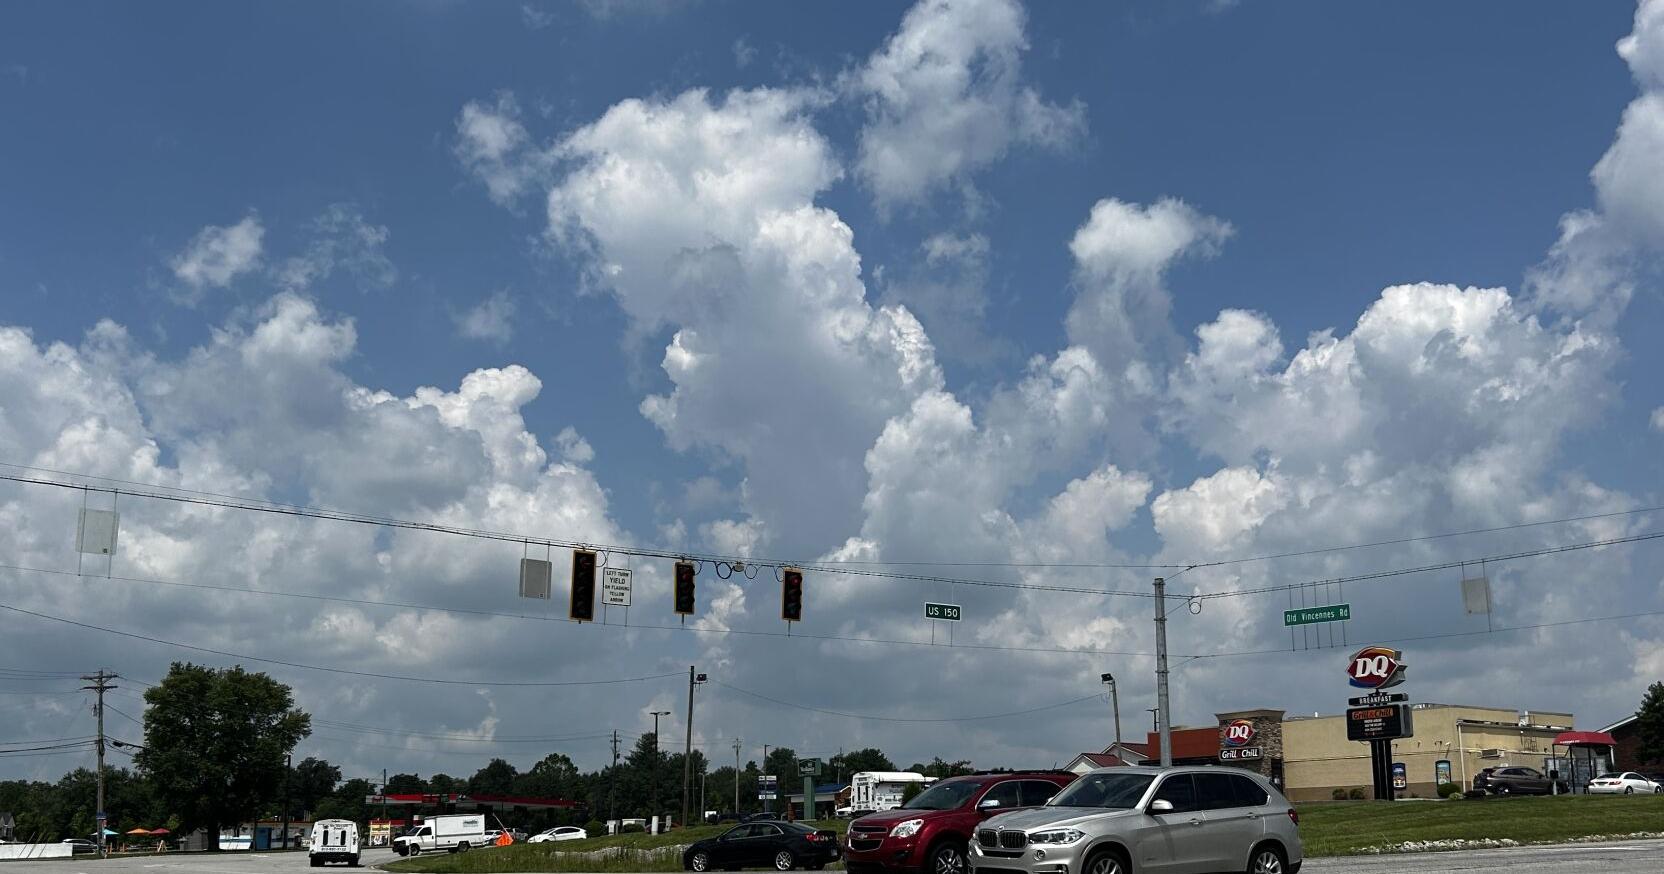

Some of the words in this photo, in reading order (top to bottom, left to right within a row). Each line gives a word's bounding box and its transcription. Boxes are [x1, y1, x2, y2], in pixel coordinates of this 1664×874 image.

[928, 606, 939, 615] US
[944, 608, 957, 617] 150
[1286, 614, 1296, 622] Old
[1301, 611, 1335, 621] Vincennes
[1339, 608, 1348, 617] Rd
[1354, 655, 1389, 678] DQ
[1359, 695, 1392, 704] BREAKFAST
[1229, 725, 1249, 739] DQ
[1222, 750, 1237, 758] Grill
[1241, 749, 1258, 757] Chill
